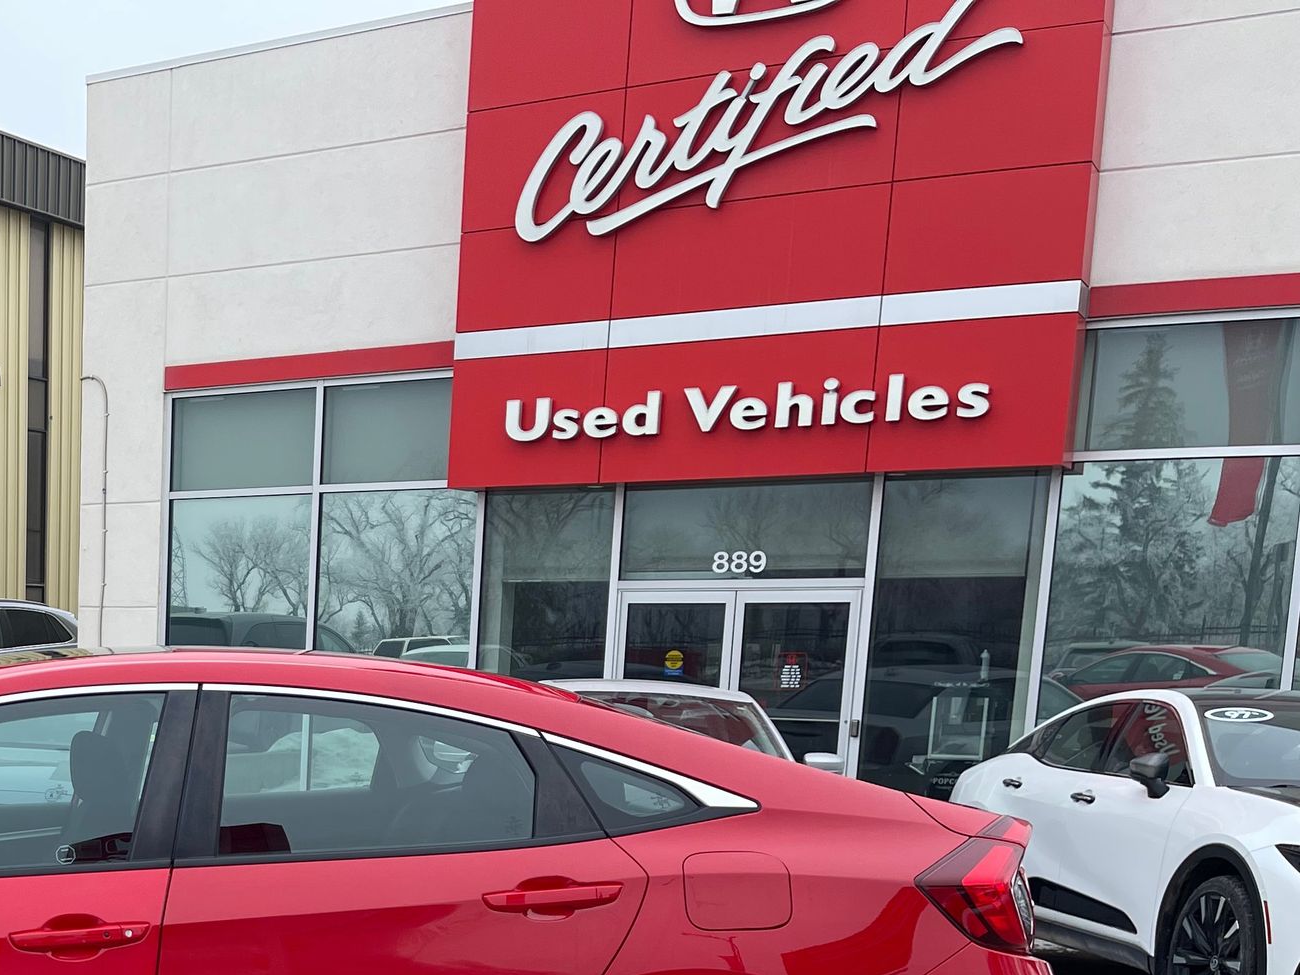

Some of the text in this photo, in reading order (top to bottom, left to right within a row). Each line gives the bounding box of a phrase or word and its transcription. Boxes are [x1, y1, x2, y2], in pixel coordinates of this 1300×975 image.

[515, 0, 1023, 242] Certified
[504, 373, 990, 442] Used Vehicles
[712, 550, 766, 573] 889
